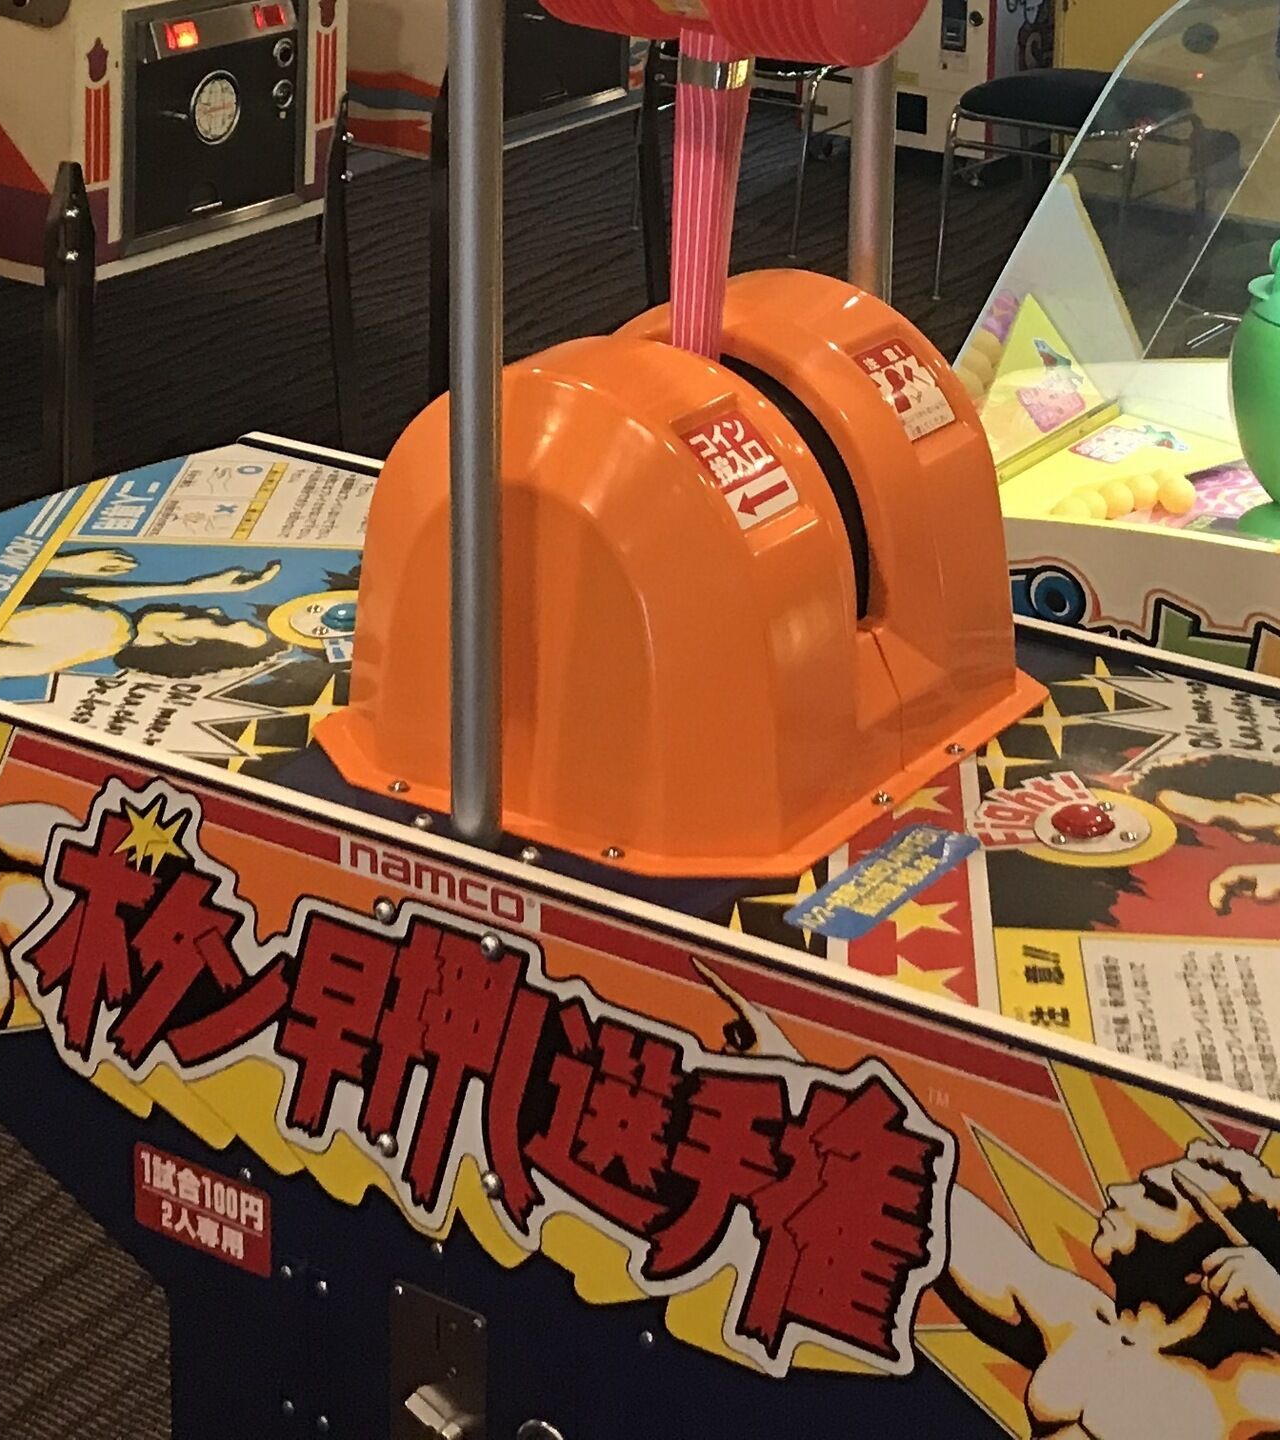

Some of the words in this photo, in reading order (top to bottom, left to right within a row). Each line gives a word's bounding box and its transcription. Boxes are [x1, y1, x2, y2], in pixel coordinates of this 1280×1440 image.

[688, 418, 745, 458] コイン
[90, 479, 161, 532] 二人専用
[972, 770, 1090, 850] Fight!
[349, 840, 525, 924] namco
[926, 1088, 952, 1109] TM
[140, 1149, 266, 1232] 1試合100円
[160, 1201, 246, 1261] 2人専用
